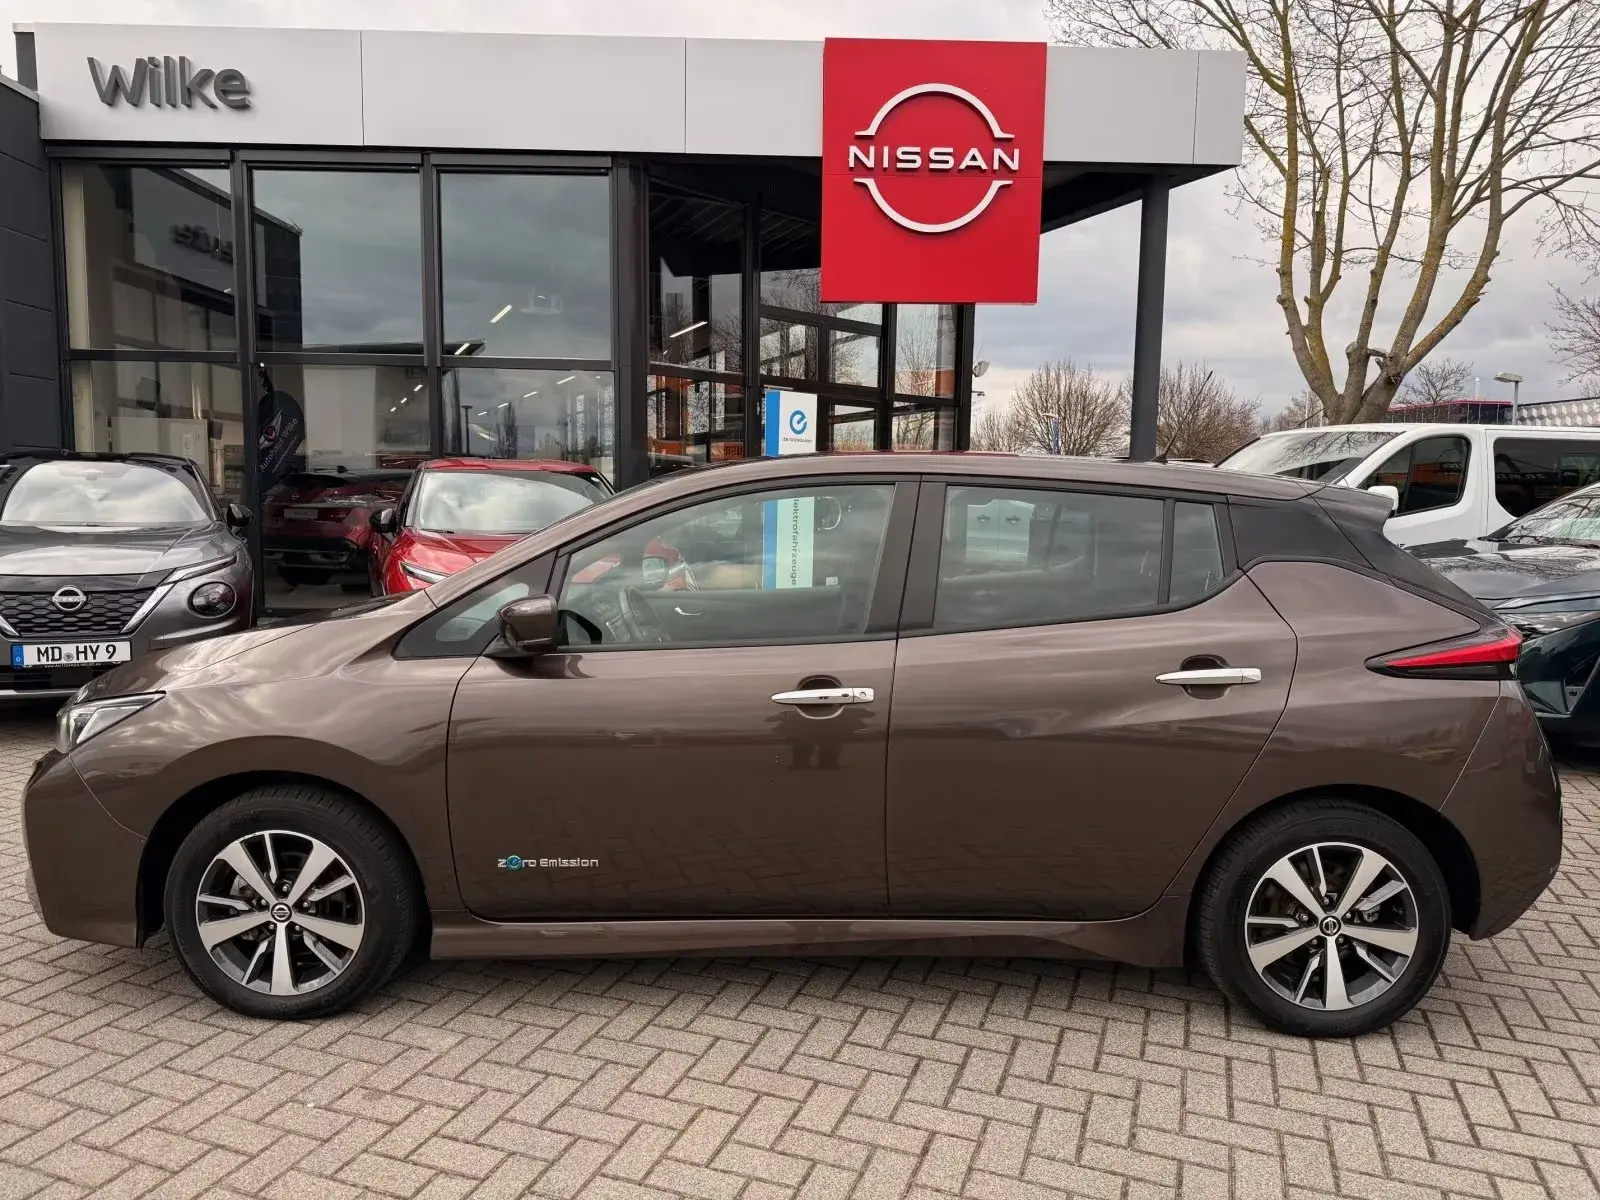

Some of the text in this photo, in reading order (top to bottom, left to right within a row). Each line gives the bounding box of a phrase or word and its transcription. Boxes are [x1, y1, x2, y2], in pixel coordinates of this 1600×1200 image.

[87, 56, 250, 107] Wilke
[849, 145, 1019, 170] NISSAN
[260, 440, 285, 472] Autohaus
[282, 418, 298, 438] Wilke
[790, 497, 799, 586] lektrofahrzeuge
[37, 646, 62, 662] MD
[75, 645, 100, 660] HY
[105, 644, 117, 659] 9
[540, 857, 599, 867] Emission
